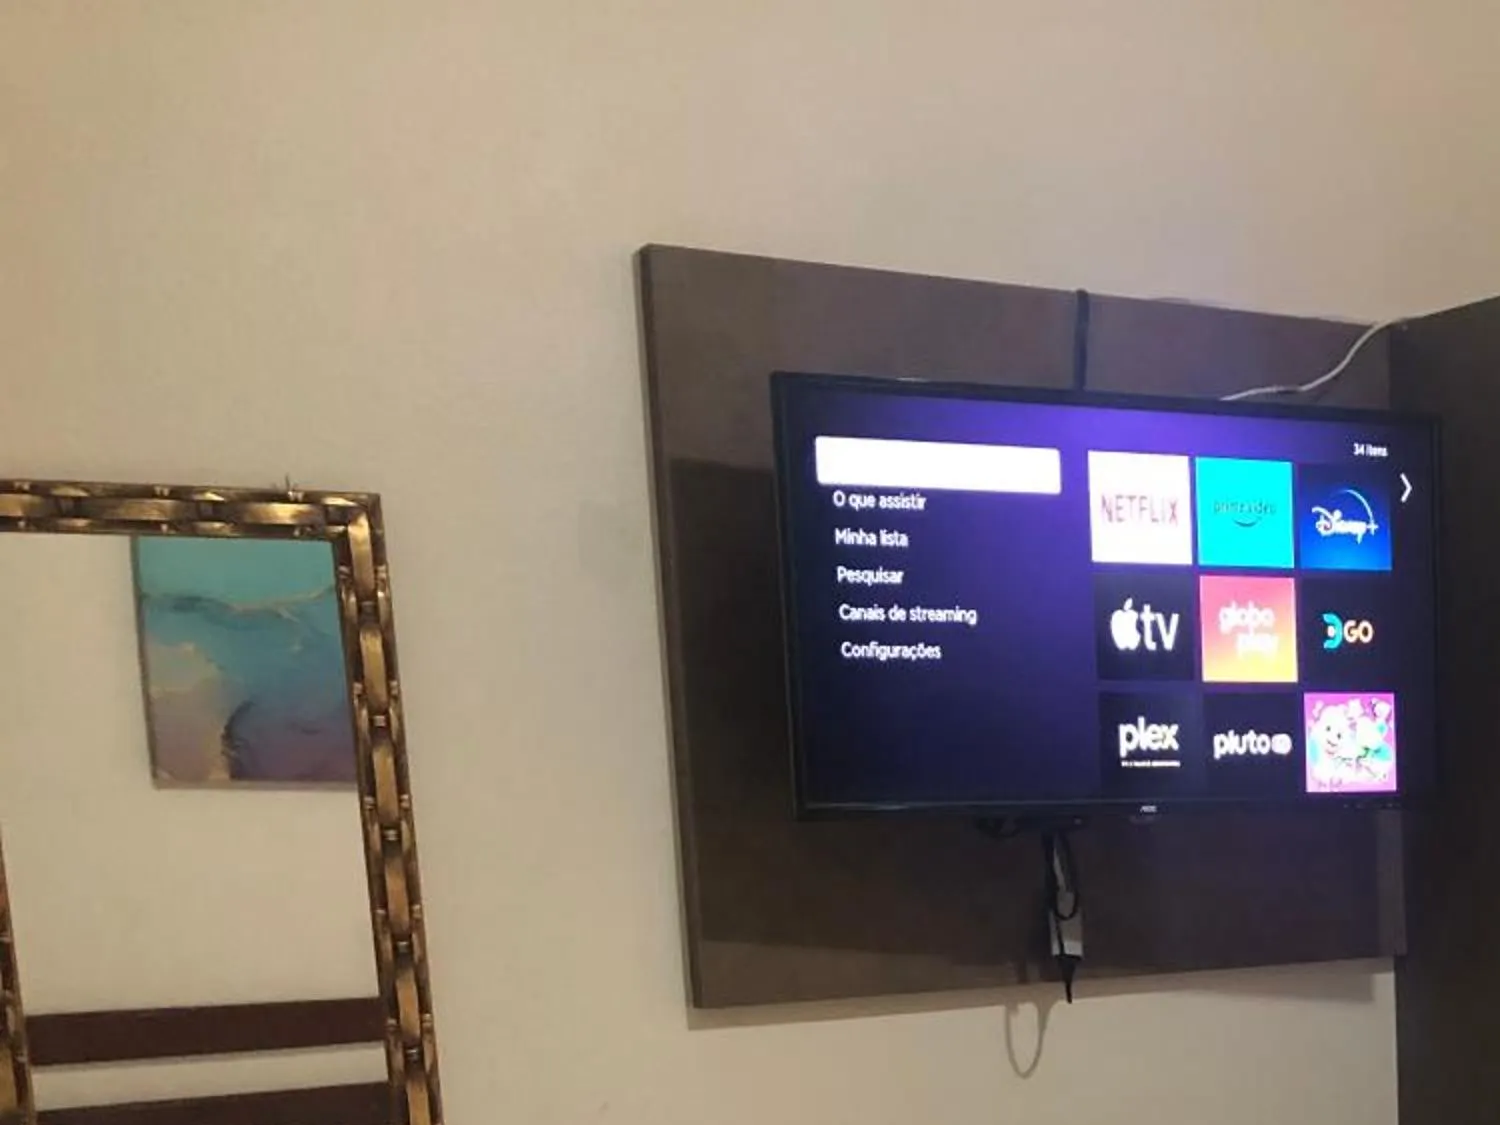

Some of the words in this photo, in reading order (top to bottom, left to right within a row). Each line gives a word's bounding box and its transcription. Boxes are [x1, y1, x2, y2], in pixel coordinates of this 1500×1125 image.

[832, 490, 846, 507] O
[848, 493, 876, 511] que
[879, 493, 927, 510] assistir
[1101, 494, 1179, 525] NETFLIX
[834, 528, 877, 546] Minha
[879, 529, 909, 547] lista
[836, 565, 904, 586] Pesquisar
[838, 603, 885, 621] Canais
[888, 604, 906, 621] de
[909, 605, 978, 626] streaming
[840, 641, 941, 661] Configurações
[1118, 715, 1180, 759] plex
